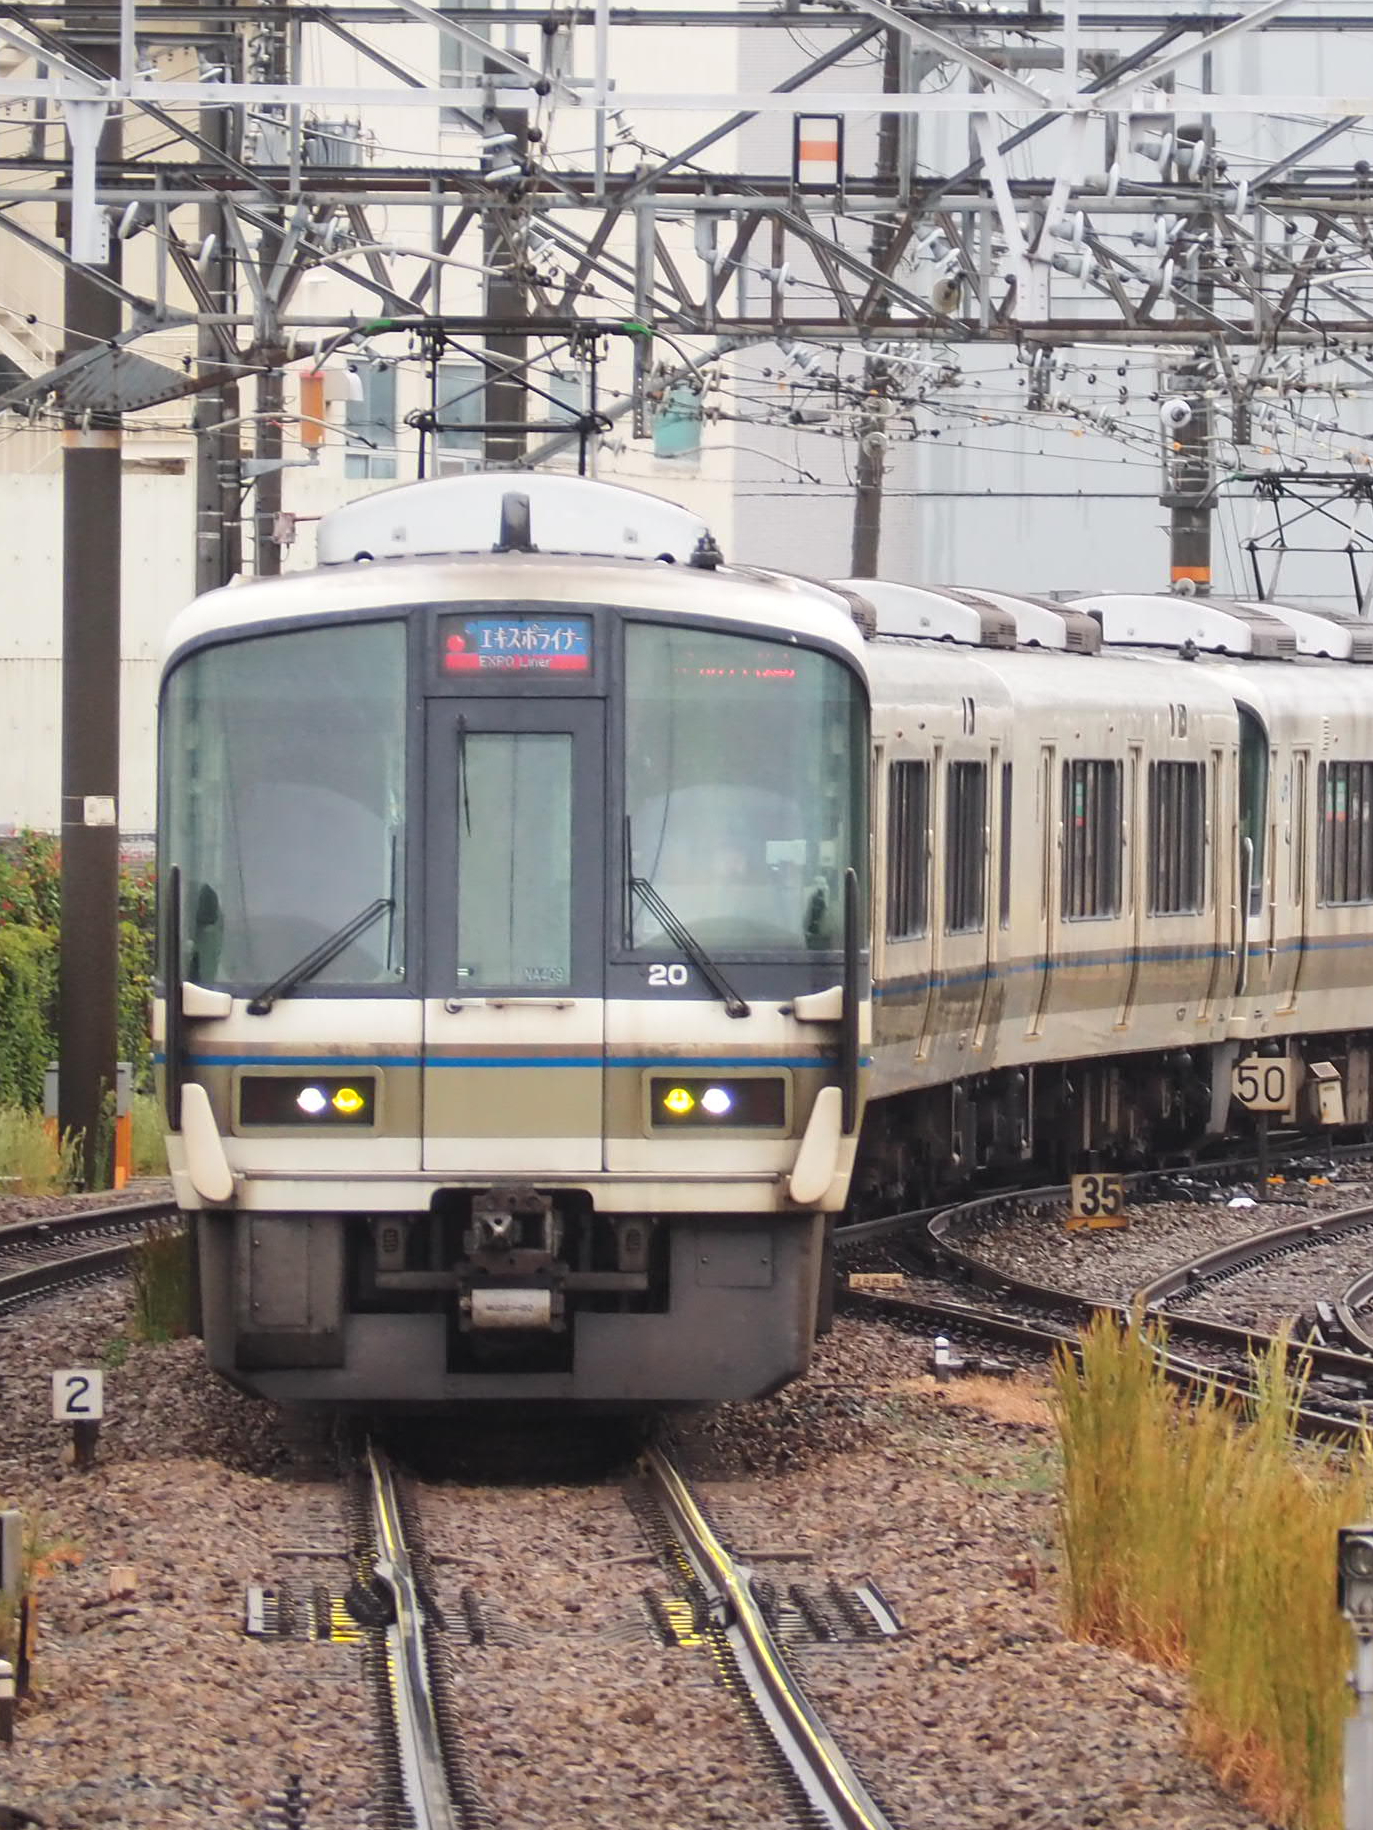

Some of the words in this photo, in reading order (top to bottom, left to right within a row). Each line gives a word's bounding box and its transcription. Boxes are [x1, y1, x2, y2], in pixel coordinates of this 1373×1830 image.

[480, 622, 584, 651] エキスポライナー
[479, 654, 515, 668] EXPO
[519, 654, 552, 668] Liner
[648, 964, 688, 986] 20
[1237, 1065, 1285, 1103] 50
[1080, 1176, 1121, 1216] 35
[65, 1376, 90, 1413] 2
